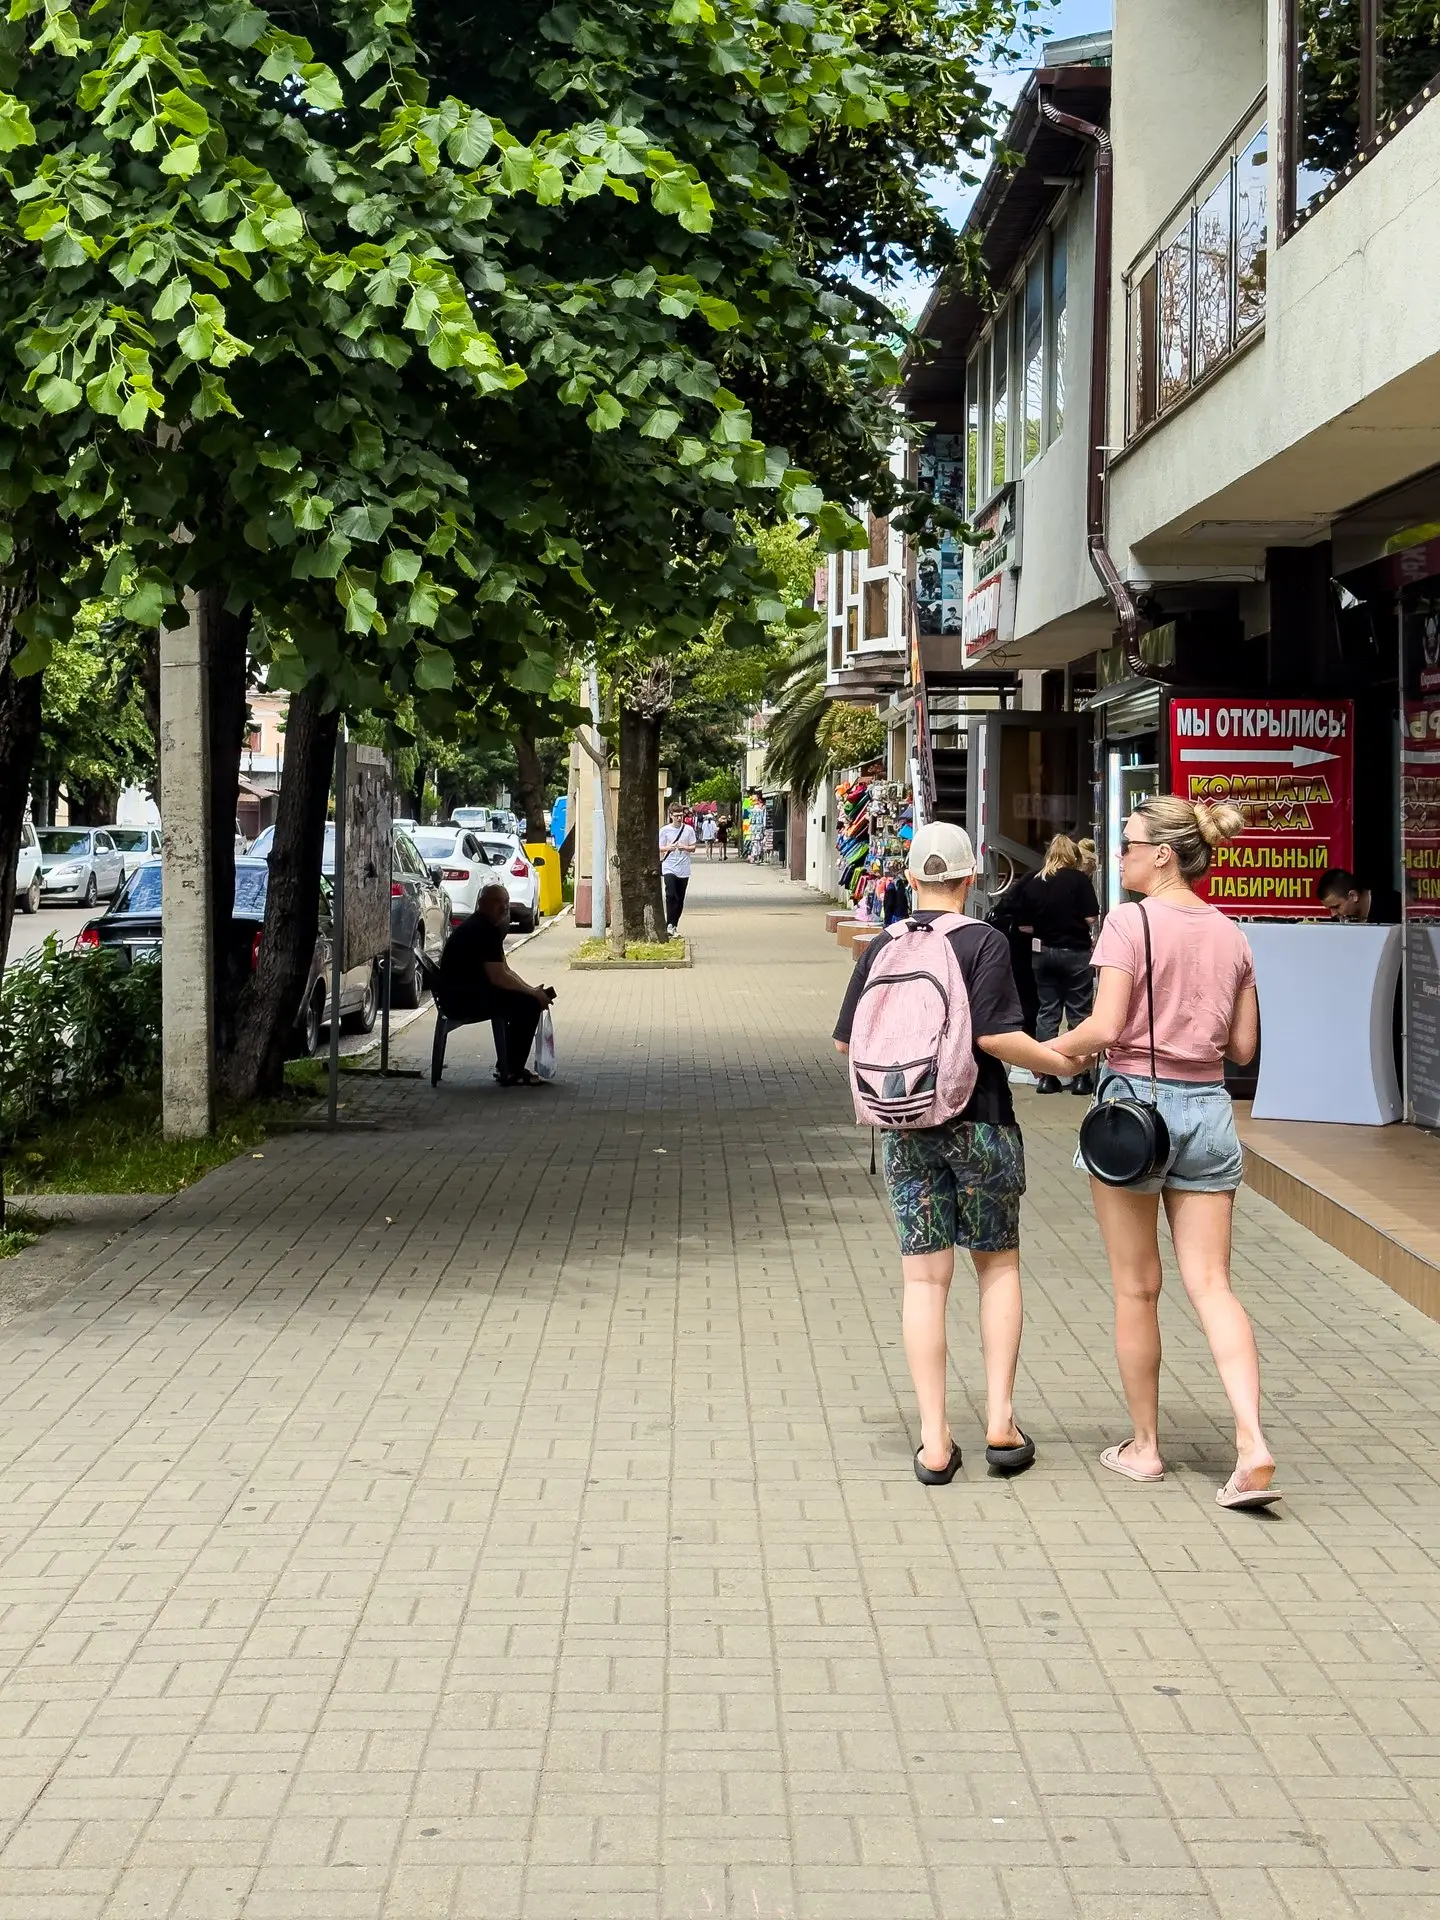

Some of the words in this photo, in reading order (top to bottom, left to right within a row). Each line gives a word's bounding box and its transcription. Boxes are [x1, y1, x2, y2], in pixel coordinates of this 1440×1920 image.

[1176, 708, 1209, 737] МЫ
[1216, 708, 1346, 738] ОТКРЫЛИСЬ!
[1188, 775, 1334, 804] КОМНАТА
[1208, 876, 1313, 898] ЛАБИРИНТ
